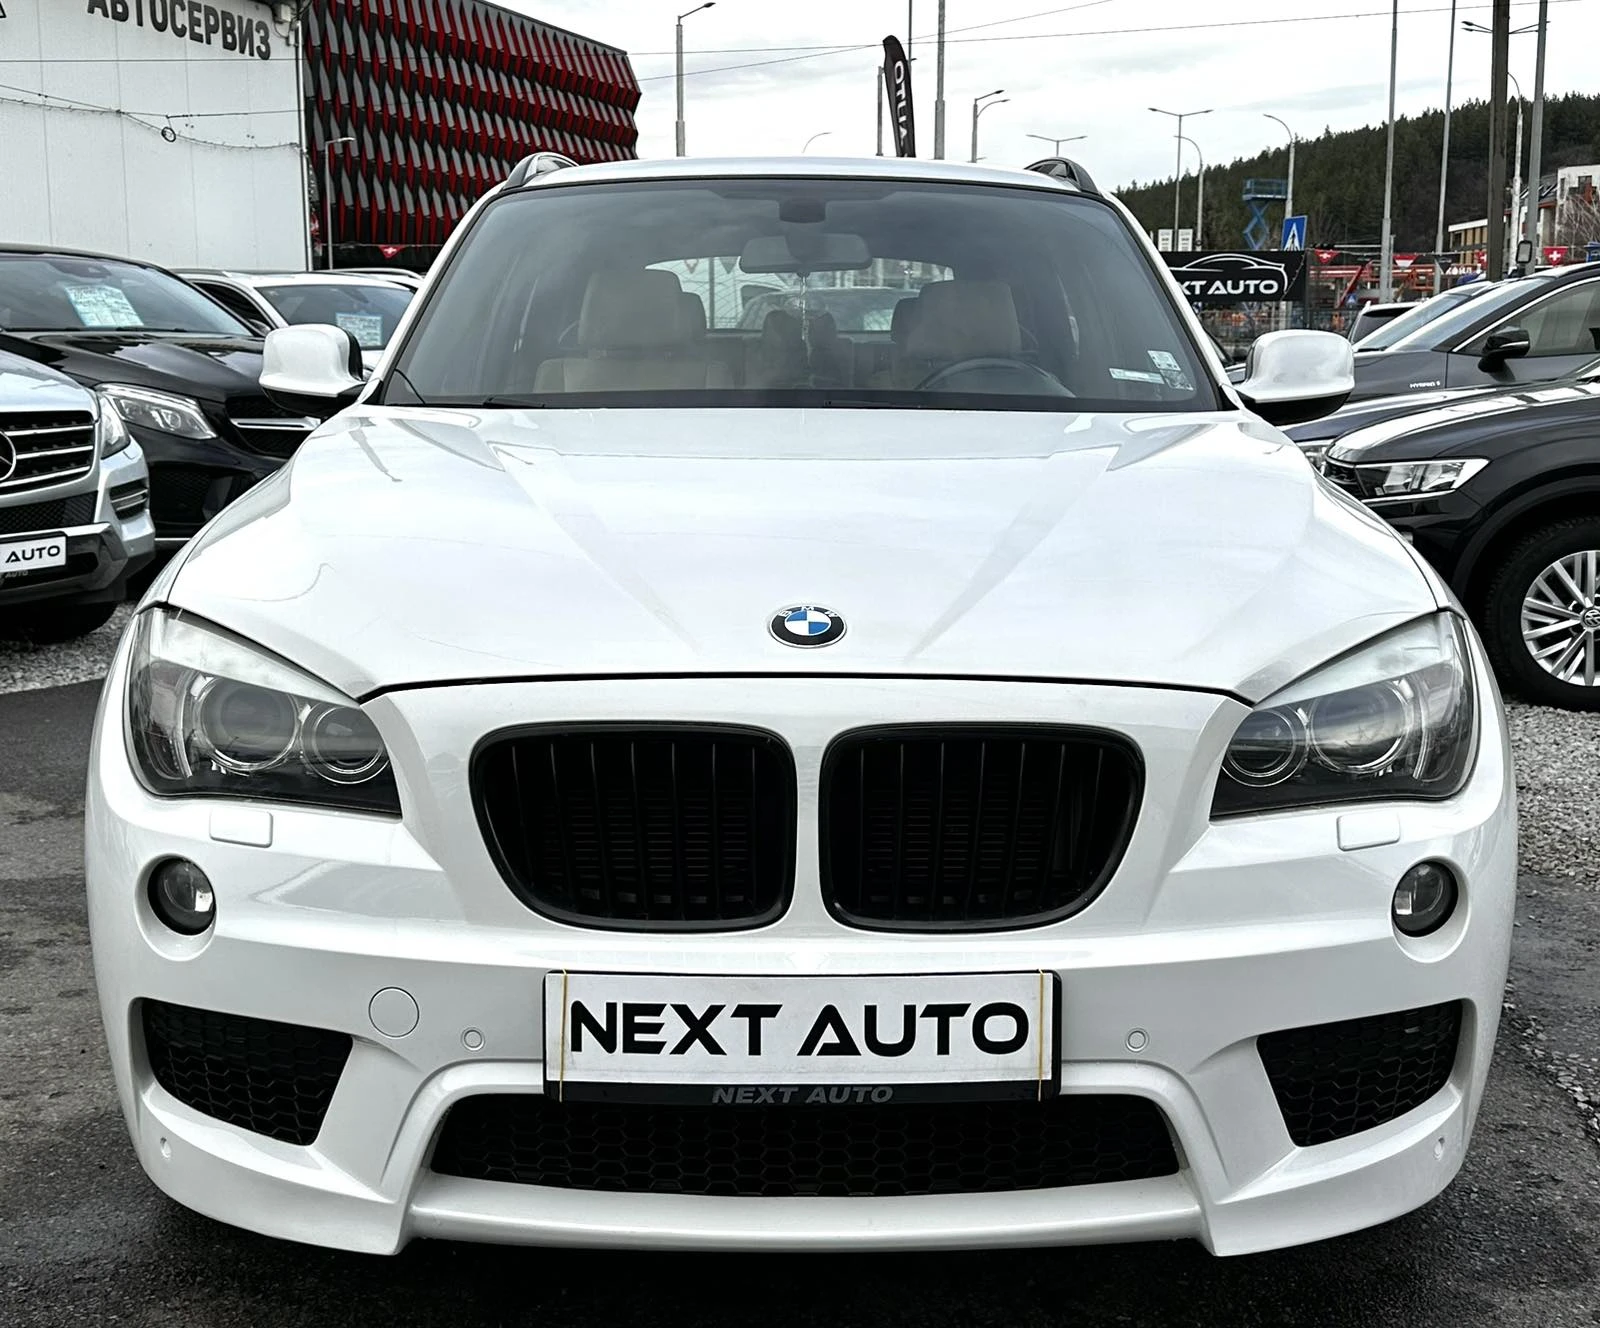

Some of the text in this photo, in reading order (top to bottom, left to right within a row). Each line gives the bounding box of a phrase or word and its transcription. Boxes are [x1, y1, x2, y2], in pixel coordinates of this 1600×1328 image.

[1207, 280, 1279, 295] AUTO
[5, 545, 60, 563] AUTO
[571, 1000, 1029, 1057] NEXT AUTO
[711, 1086, 893, 1104] NEXT AUTO
